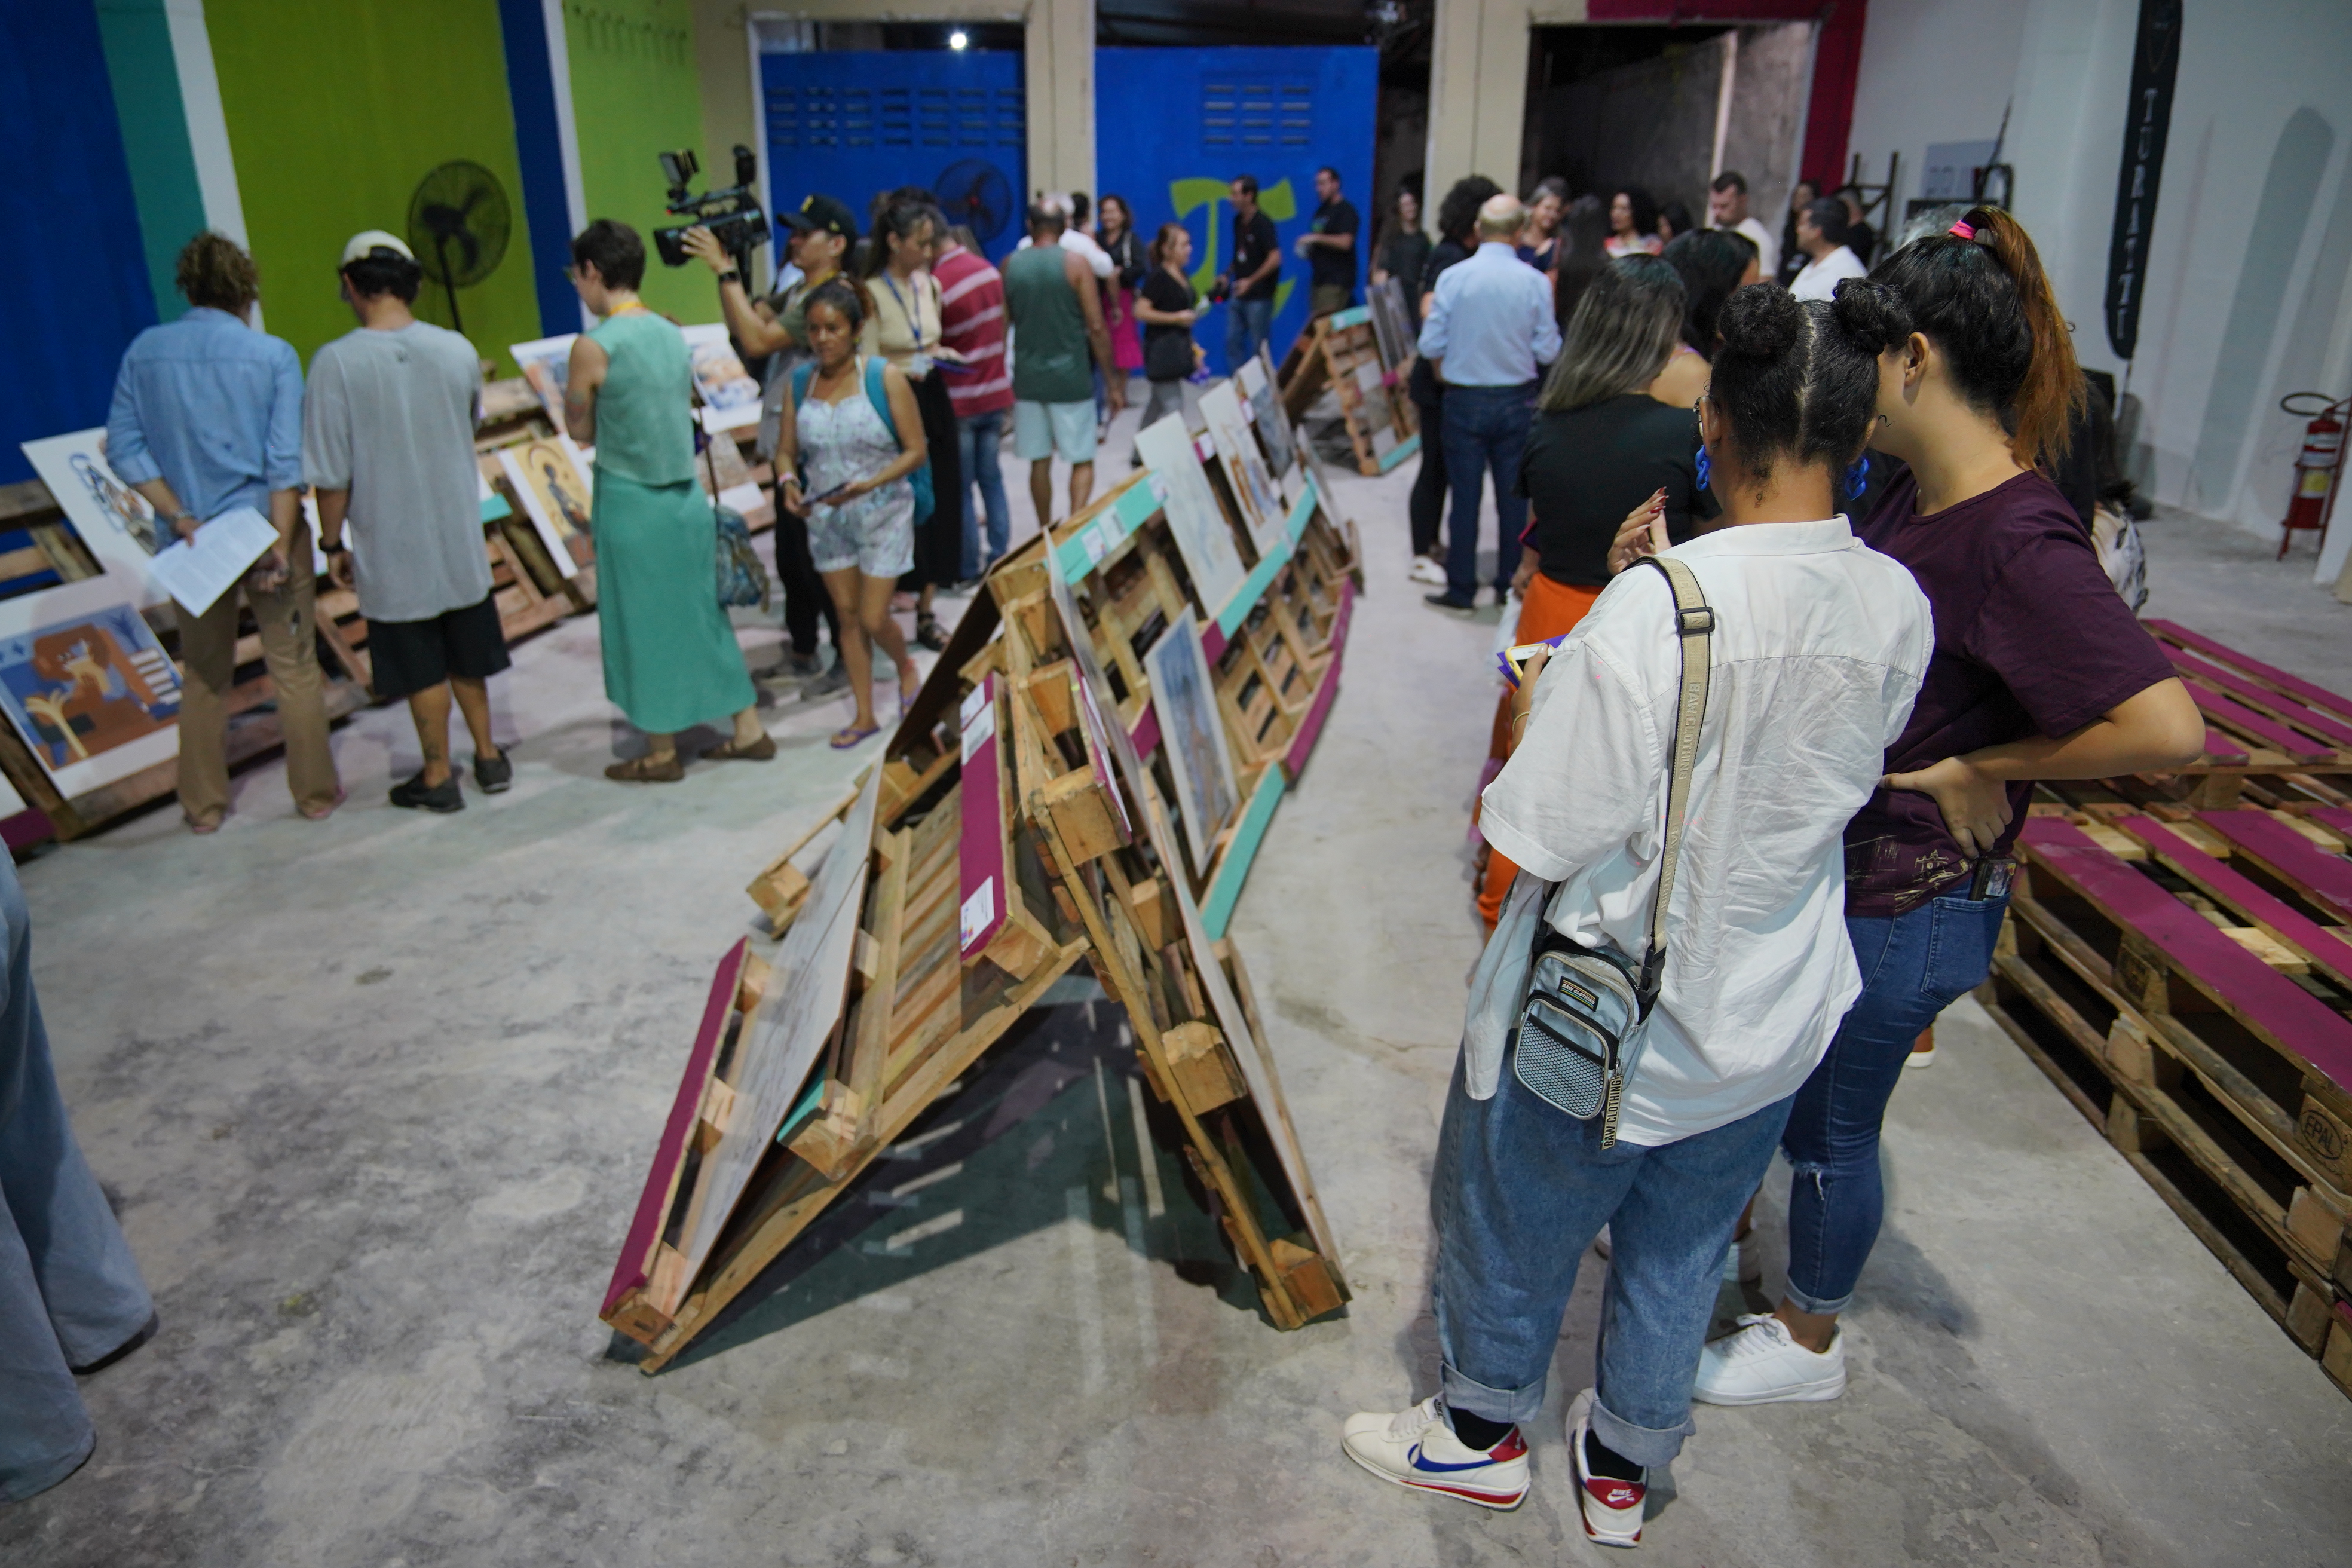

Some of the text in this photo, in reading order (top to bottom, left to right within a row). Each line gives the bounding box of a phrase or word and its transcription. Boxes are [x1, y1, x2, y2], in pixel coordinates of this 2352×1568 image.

[2117, 88, 2158, 339] TURATTI
[1679, 682, 1701, 779] BAW CLOTHING
[1561, 983, 1595, 1005] BAW CLOTHING
[1604, 1079, 1622, 1147] BAW CLOTHING
[2305, 1115, 2334, 1156] EPAL
